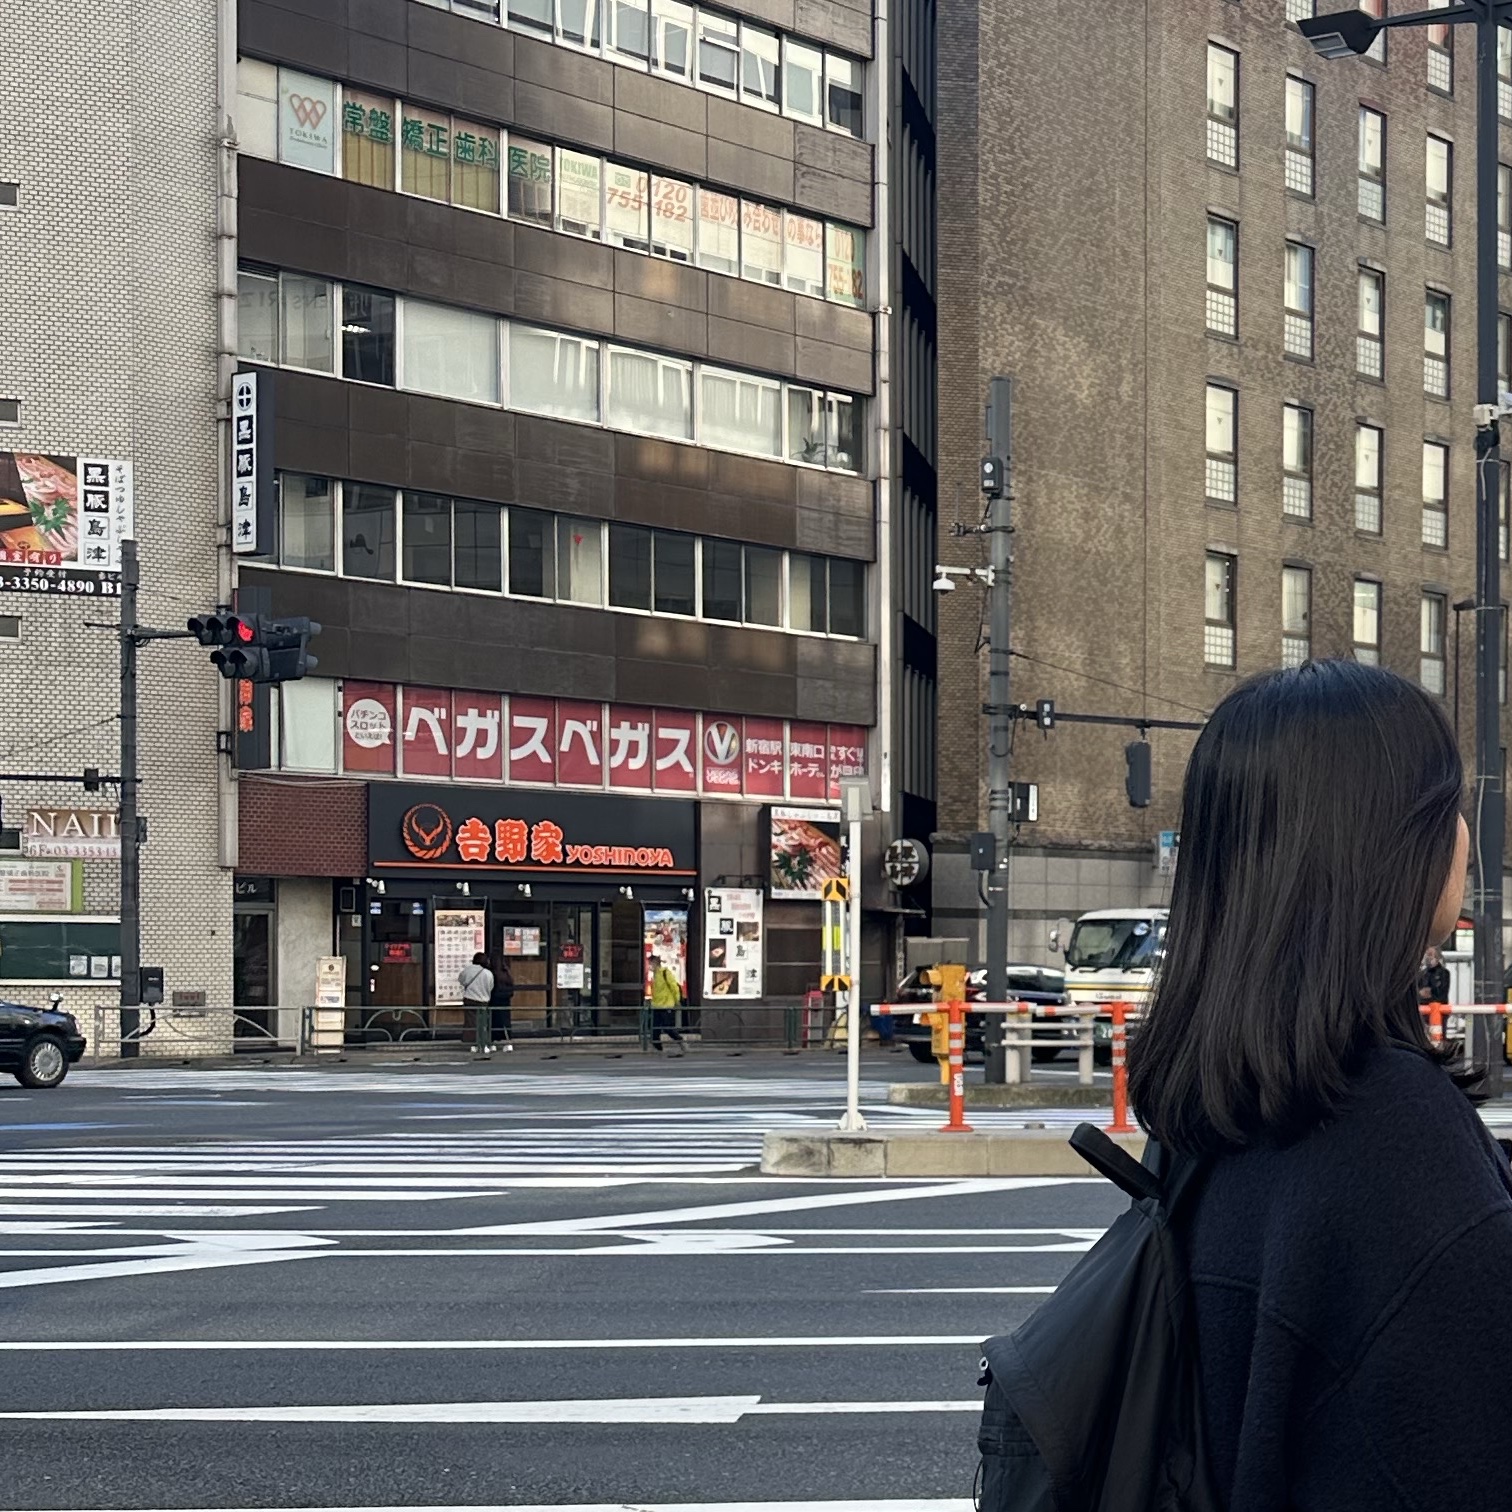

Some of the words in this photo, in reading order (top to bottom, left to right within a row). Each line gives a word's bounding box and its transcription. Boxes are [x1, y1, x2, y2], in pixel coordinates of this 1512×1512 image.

[635, 176, 687, 203] 0120
[85, 464, 107, 563] 黒豚島津
[350, 708, 387, 721] パチンコ
[350, 720, 386, 731] スロット
[404, 706, 695, 773] ベガスベガス
[455, 816, 564, 864] 吉野家
[565, 844, 675, 868] YOSHINOYA
[235, 881, 258, 895] ビル
